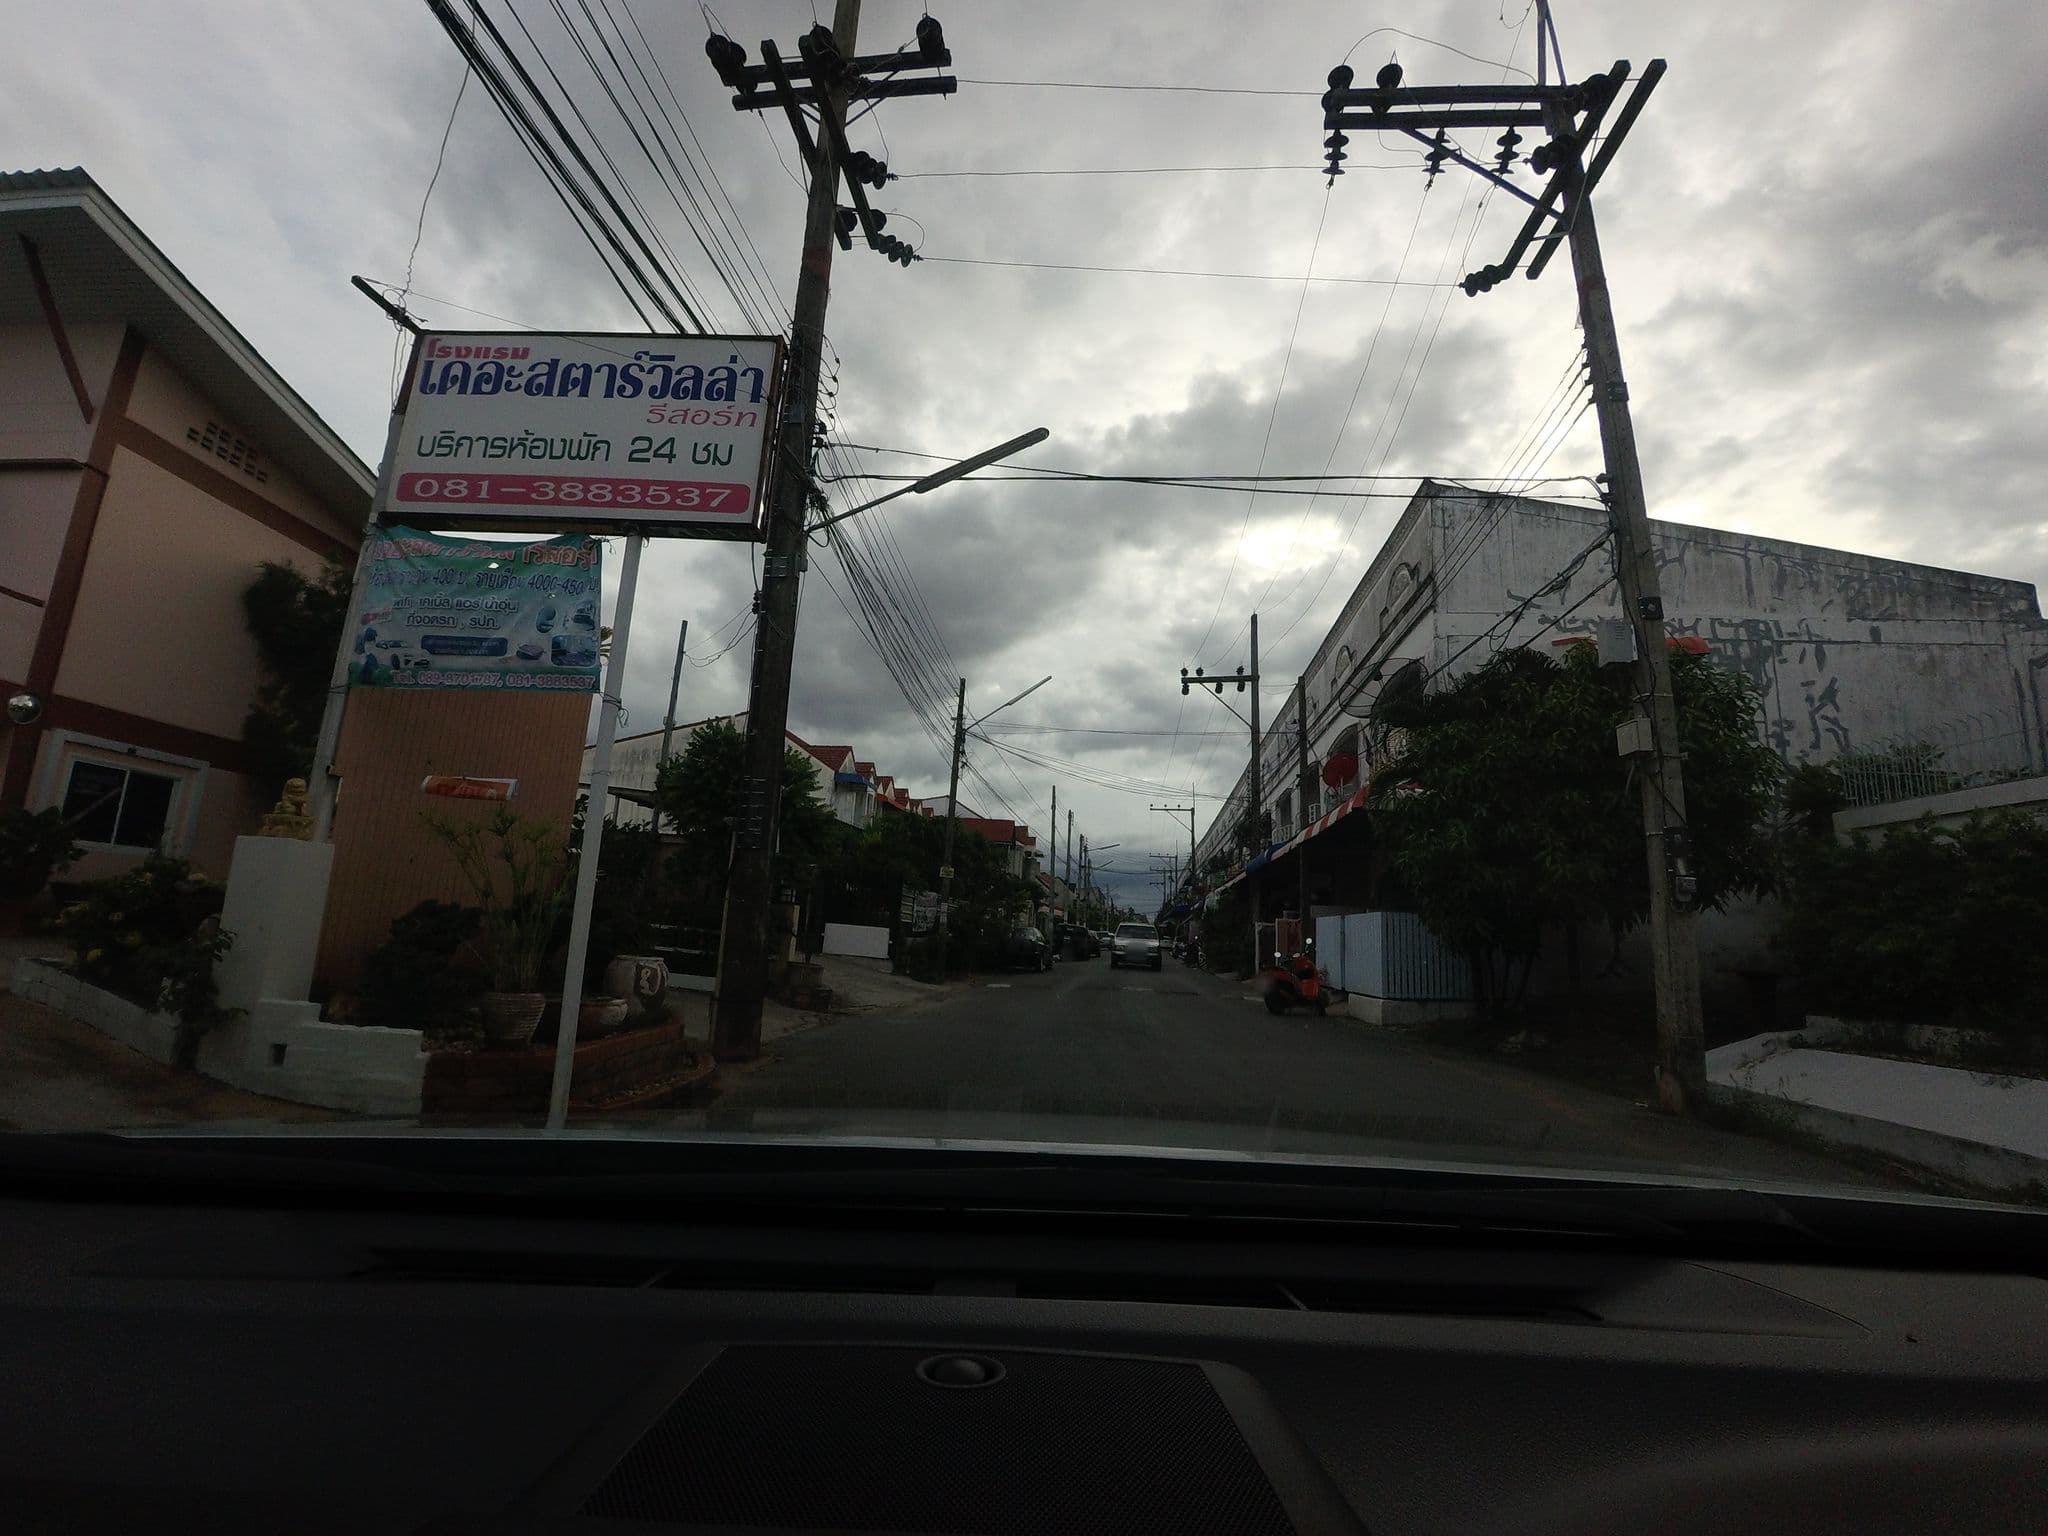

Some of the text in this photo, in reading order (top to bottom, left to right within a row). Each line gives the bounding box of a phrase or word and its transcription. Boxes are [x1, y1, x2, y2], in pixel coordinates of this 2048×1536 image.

[425, 337, 531, 360] โรงแรม
[418, 350, 765, 403] เดอะสตาร์วิลล่า
[646, 404, 757, 428] รีสอร์ท
[416, 429, 734, 466] บริการห้องพัก 24 ชม
[413, 477, 733, 509] 081-3883537
